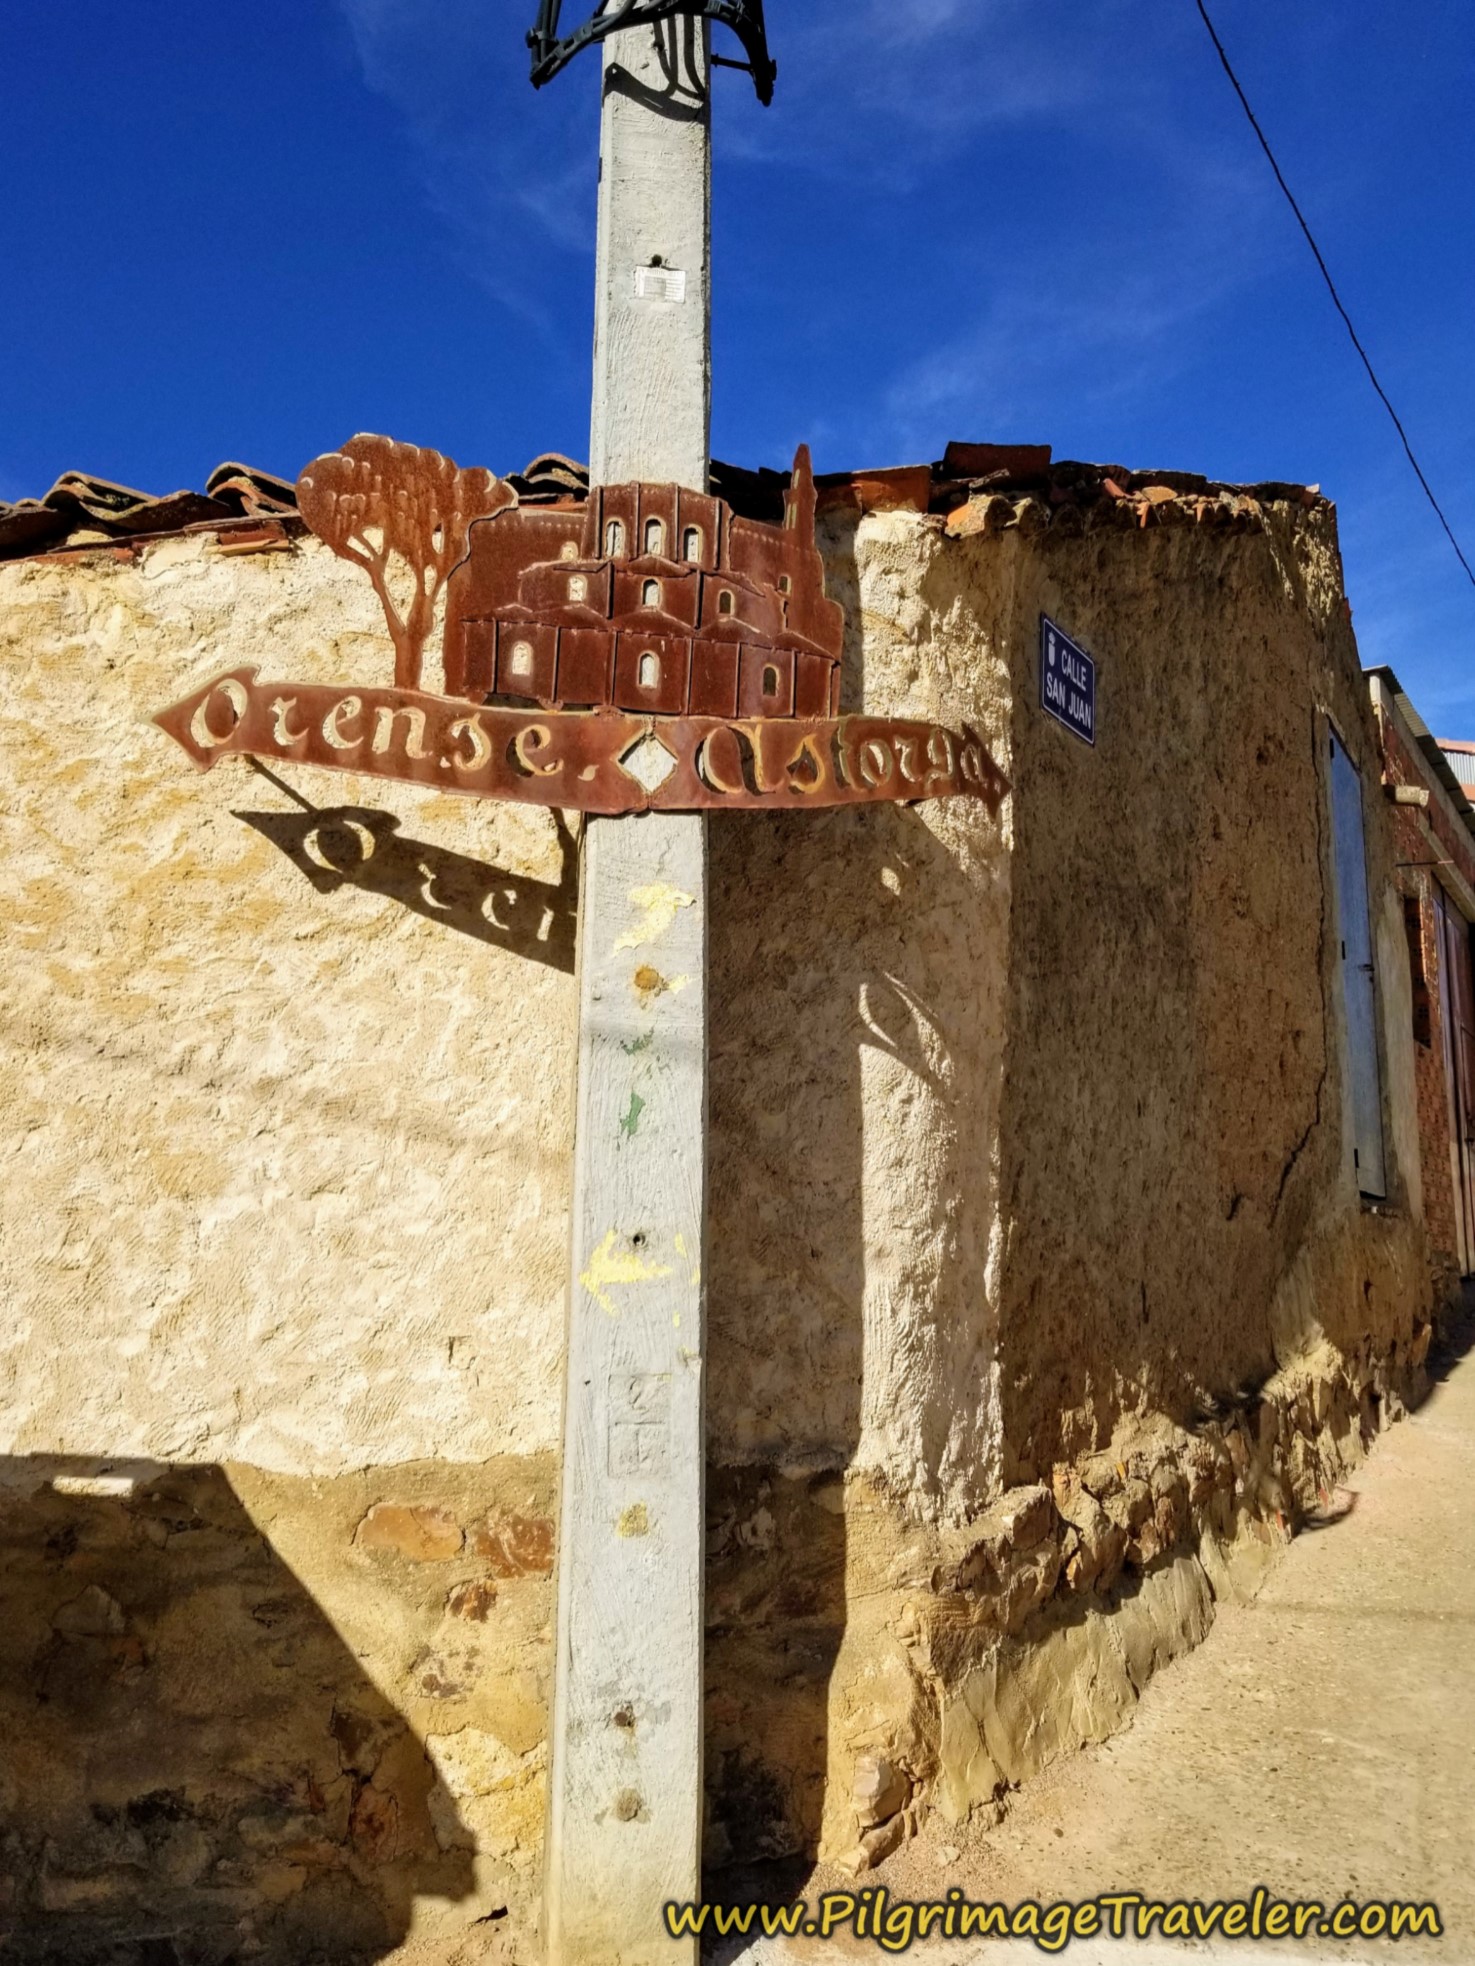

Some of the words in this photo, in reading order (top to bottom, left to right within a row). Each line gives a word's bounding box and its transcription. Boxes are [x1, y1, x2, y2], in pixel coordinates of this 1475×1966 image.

[1061, 650, 1086, 692] CALLE
[1046, 672, 1066, 709] SAN
[1068, 692, 1091, 729] JUAN
